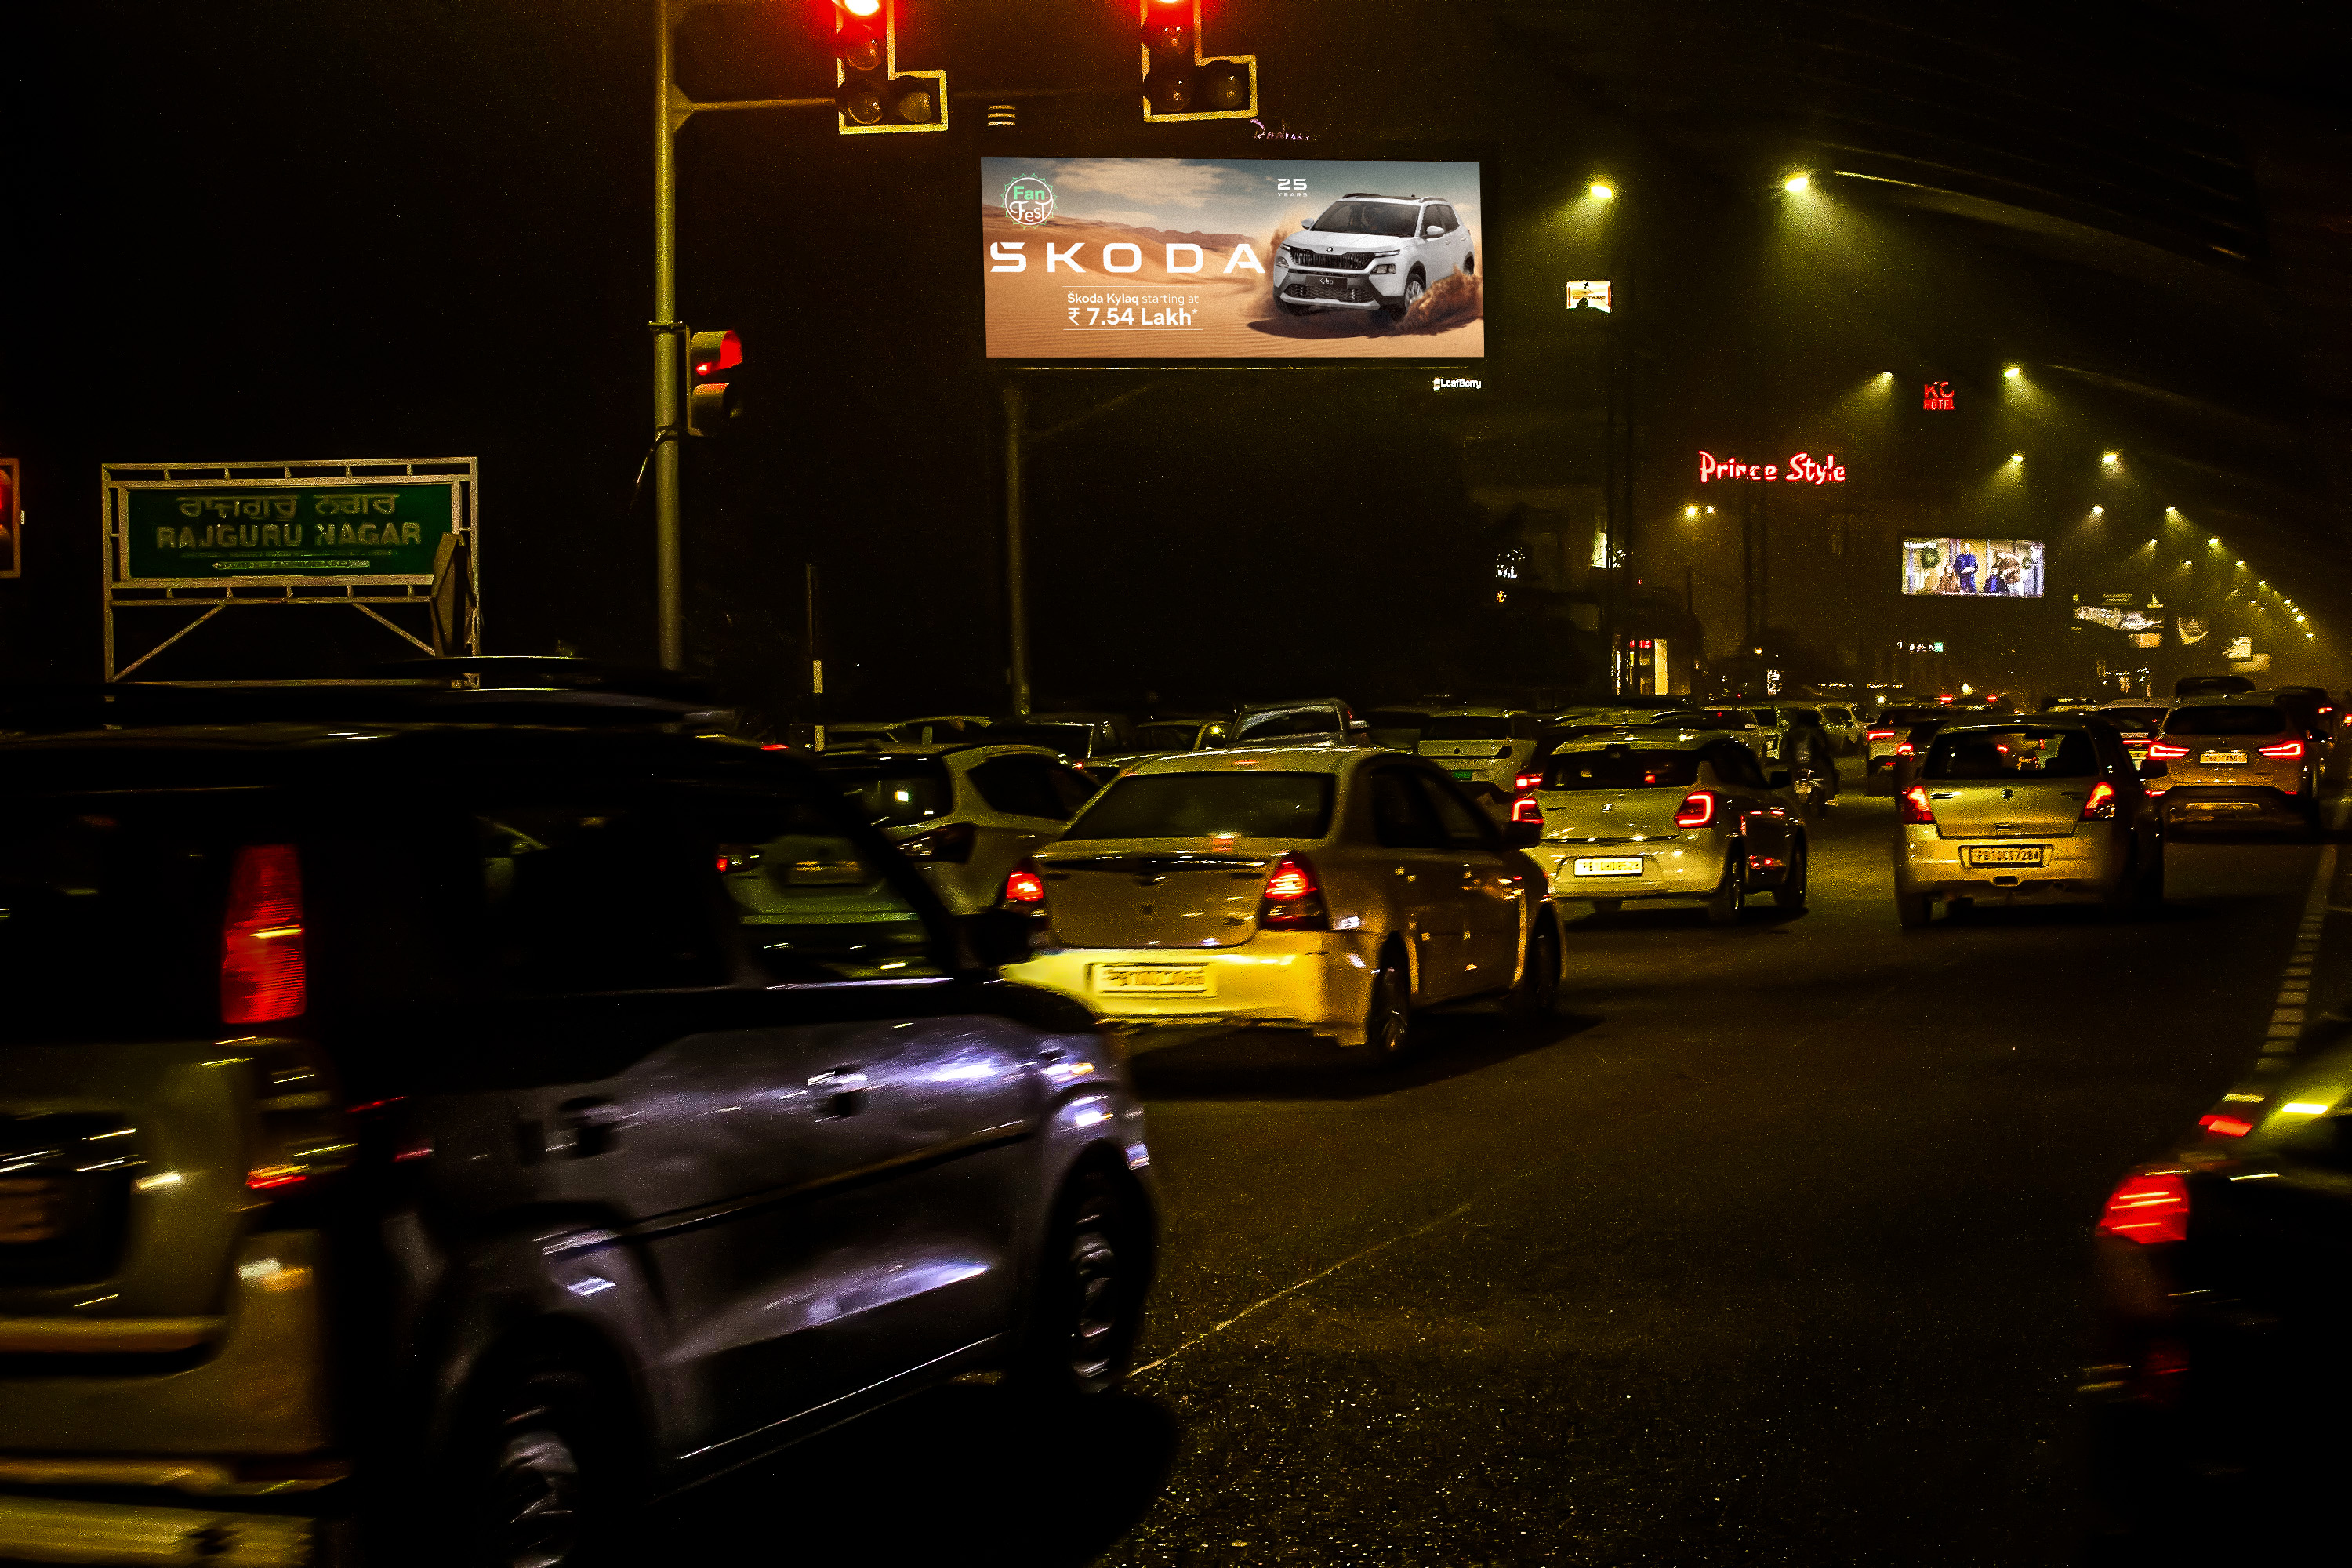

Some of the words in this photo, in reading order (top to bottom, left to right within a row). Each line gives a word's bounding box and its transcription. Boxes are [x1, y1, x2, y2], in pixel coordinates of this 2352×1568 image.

[1277, 178, 1308, 191] 25
[1013, 186, 1045, 201] Fan
[1067, 291, 1104, 303] Škoda
[1106, 292, 1139, 306] Kylaq
[1142, 293, 1185, 306] starting
[1188, 295, 1200, 303] at
[1068, 307, 1080, 325] ₹
[1087, 307, 1135, 325] 7.54
[1923, 398, 1955, 410] HOTEL
[1697, 450, 1778, 484] Prince
[1784, 452, 1846, 485] Style
[156, 523, 303, 549] RAJGURU
[314, 522, 422, 546] NAGAR
